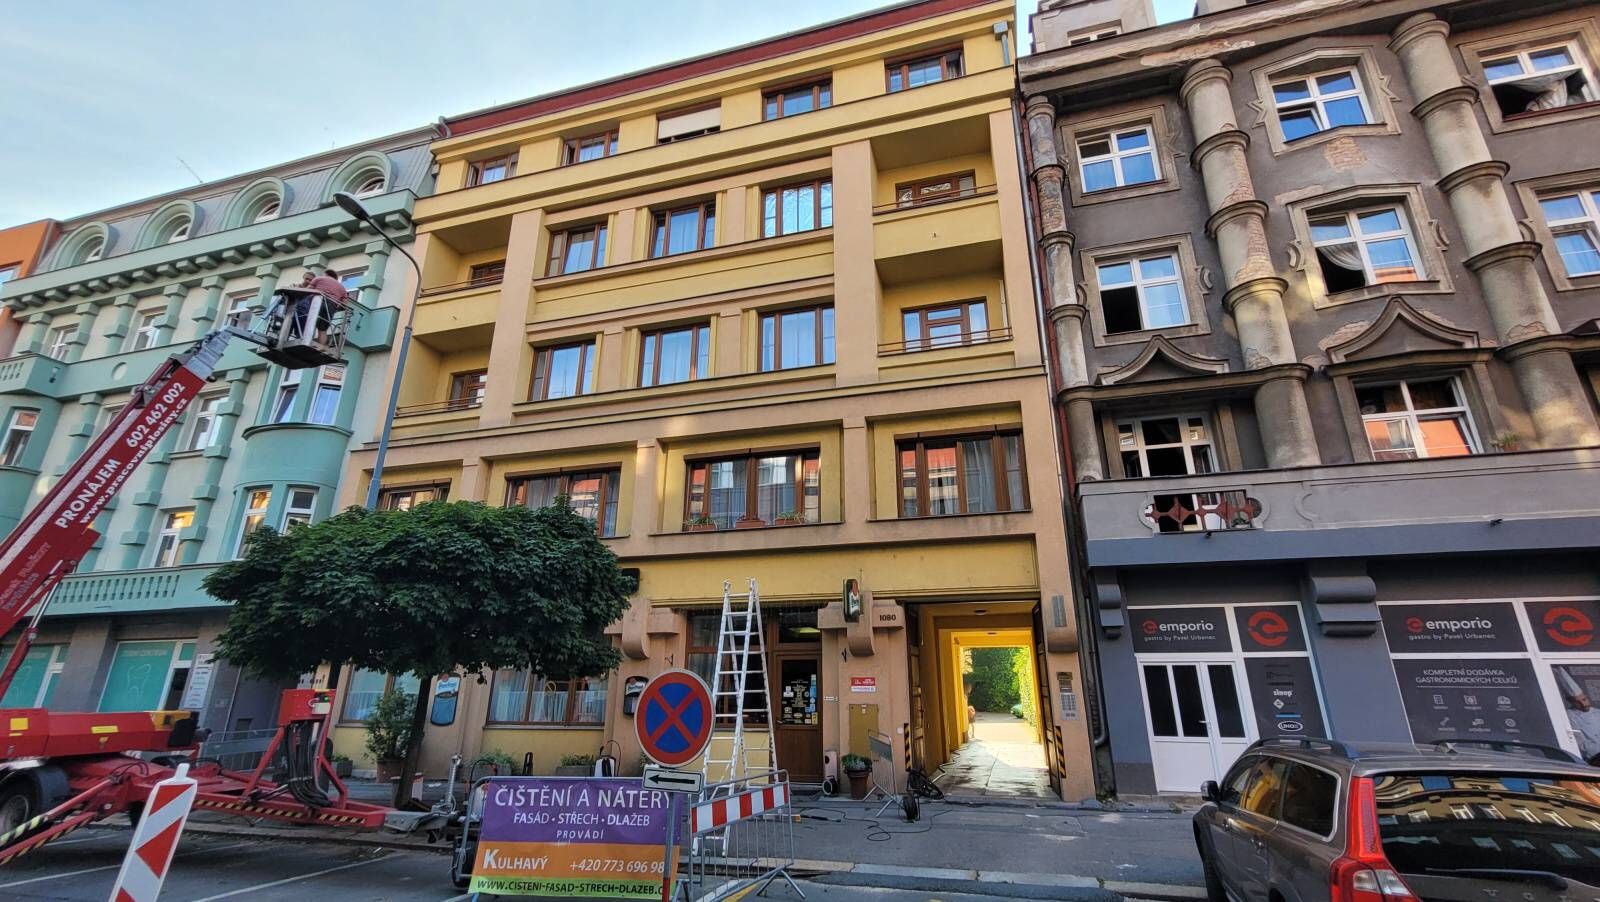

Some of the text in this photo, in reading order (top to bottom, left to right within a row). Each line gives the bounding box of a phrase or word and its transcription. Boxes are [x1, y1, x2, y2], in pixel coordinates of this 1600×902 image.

[55, 382, 186, 528] PRONÁJEM 602 462 002
[79, 398, 188, 523] www.pracovniplosiny.cz
[879, 614, 897, 622] 1080
[1426, 617, 1492, 632] emporio
[1158, 620, 1214, 634] emporio
[1423, 668, 1505, 676] KOMPLETNÍ DODÁVKA
[495, 785, 573, 807] ČIŠTĚNÍ
[577, 789, 590, 807] A
[513, 812, 651, 826] FASÁD STŘECH DLAŽEB
[556, 829, 605, 840] PROVÁDÍ
[570, 859, 600, 872] +420
[602, 860, 624, 873] 773
[627, 861, 647, 873] 696
[650, 861, 665, 874] 98
[477, 880, 664, 896] WWW.CISTENI-FASAD-STRECH-DLAZEB.C
